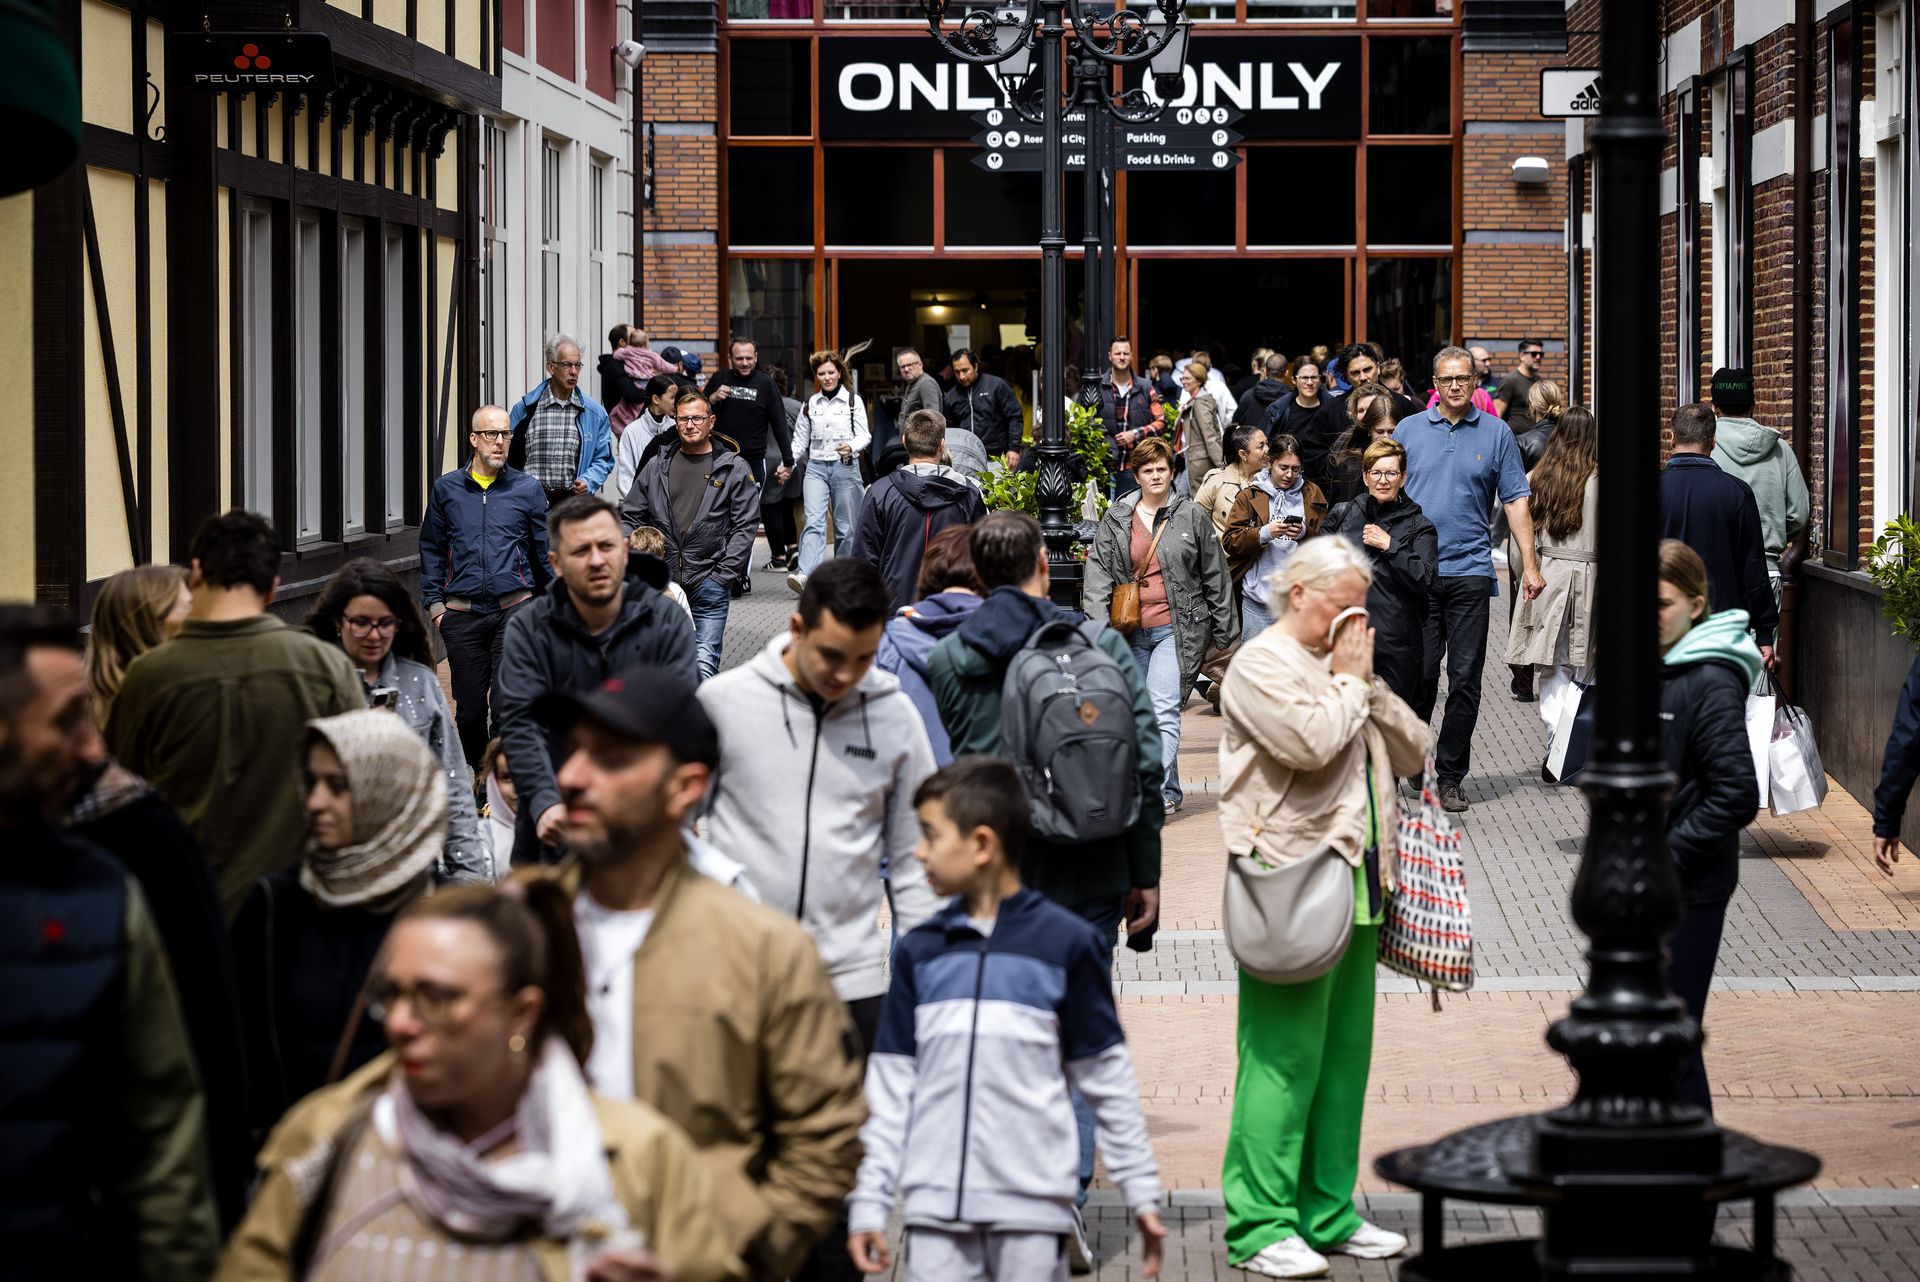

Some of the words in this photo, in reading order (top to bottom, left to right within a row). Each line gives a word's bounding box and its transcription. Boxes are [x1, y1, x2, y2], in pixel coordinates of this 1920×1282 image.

[194, 74, 315, 83] PEUTEREY
[1142, 62, 1342, 111] ONLY
[1126, 132, 1167, 145] Parking
[1127, 154, 1152, 165] Food
[1153, 154, 1161, 165] &
[1163, 154, 1196, 165] Drinks
